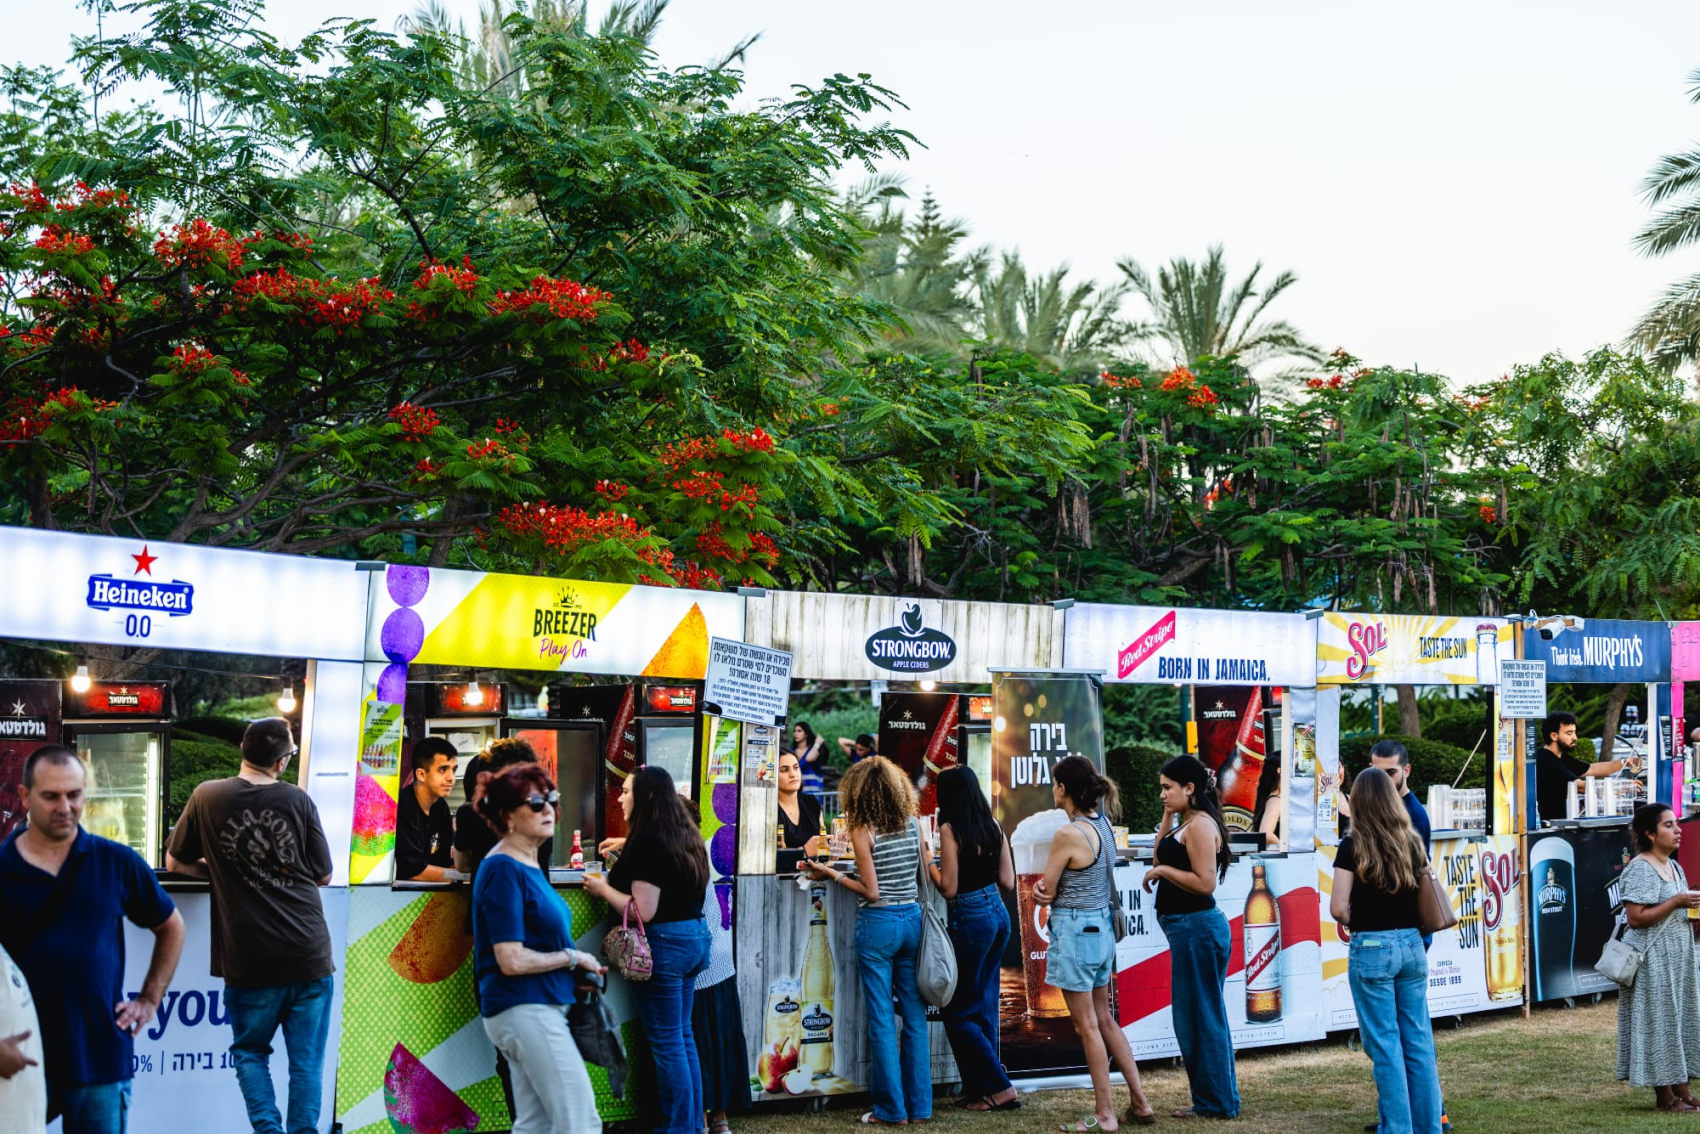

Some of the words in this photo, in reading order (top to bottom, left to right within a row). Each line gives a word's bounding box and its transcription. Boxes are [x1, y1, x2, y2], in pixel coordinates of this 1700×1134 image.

[92, 580, 187, 609] Heineken
[125, 613, 151, 638] 0.0
[533, 608, 597, 642] BREEZER
[540, 637, 570, 665] Play
[572, 639, 588, 659] On
[713, 651, 720, 662] לו
[739, 646, 749, 657] של
[766, 652, 773, 660] או
[1120, 644, 1143, 673] Red
[1143, 619, 1175, 653] Stripe
[1419, 636, 1440, 659] TASTE
[1441, 637, 1452, 659] THE
[1453, 637, 1468, 659] SUN
[1551, 646, 1568, 666] Think
[1583, 634, 1643, 670] MURPHY'S
[721, 654, 735, 665] מלאו
[737, 658, 753, 669] שטרם
[773, 655, 790, 666] מכירה
[893, 660, 909, 668] APPLE
[910, 661, 929, 669] CIDERS
[1158, 656, 1192, 680] BORN
[1197, 657, 1210, 680] IN
[1215, 658, 1271, 682] JAMAICA.
[750, 671, 763, 683] שנה
[763, 675, 771, 684] 18
[888, 720, 926, 730] גולדסטאר
[1203, 710, 1236, 719] גולדסטאר
[0, 719, 46, 736] גולדסטא
[1030, 723, 1067, 751] בירה
[1011, 752, 1051, 789] גלוטן
[1224, 815, 1247, 827] OLDS
[218, 808, 296, 864] BILLABONG
[1443, 854, 1476, 886] TASTE
[1129, 889, 1141, 911] IN
[1457, 886, 1478, 917] THE
[1125, 915, 1148, 936] ICA.
[1458, 917, 1479, 950] SUN
[1030, 950, 1047, 960] GLU
[1430, 978, 1447, 987] DESDE
[147, 990, 232, 1041] you
[172, 1052, 214, 1071] בירה
